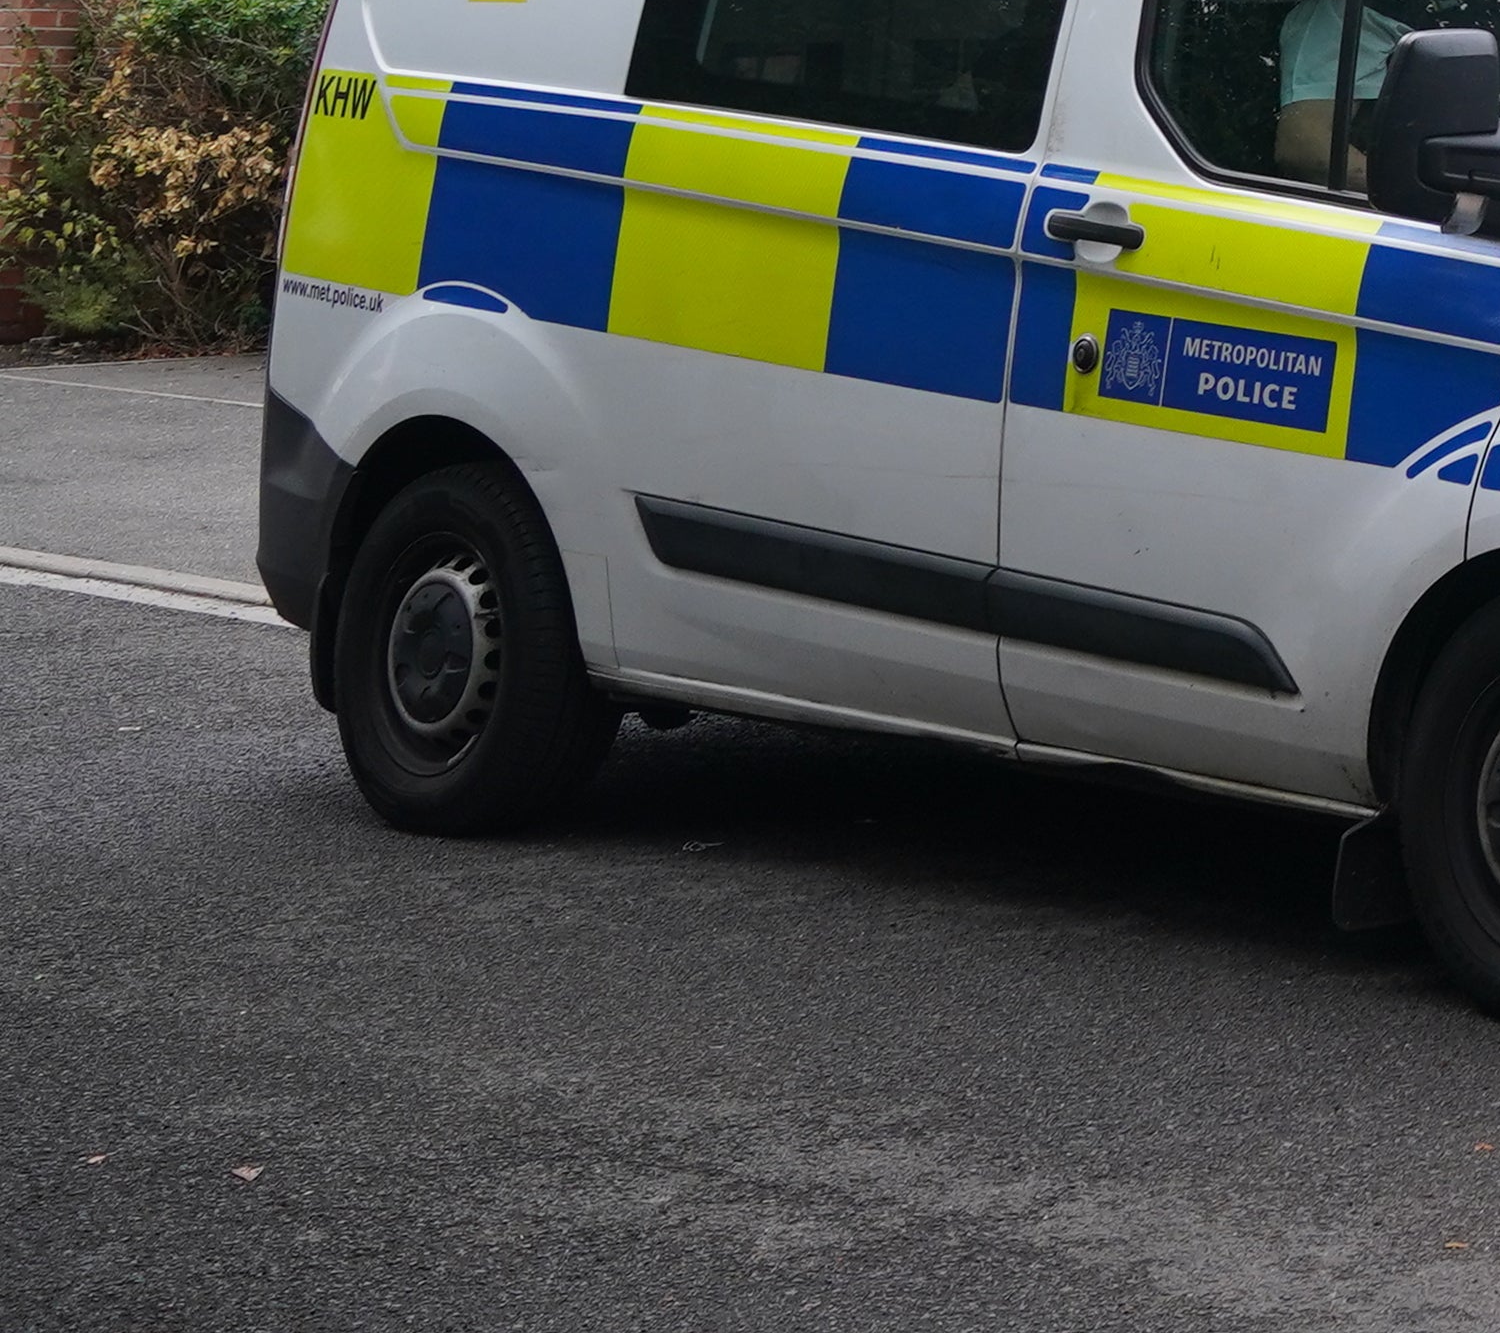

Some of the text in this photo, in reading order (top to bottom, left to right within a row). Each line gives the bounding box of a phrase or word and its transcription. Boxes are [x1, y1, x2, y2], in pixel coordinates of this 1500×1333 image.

[314, 74, 376, 120] KHW
[283, 278, 384, 313] www.met.police.uk
[1183, 337, 1323, 376] METROPOLITAN
[1198, 373, 1298, 410] POLICE
